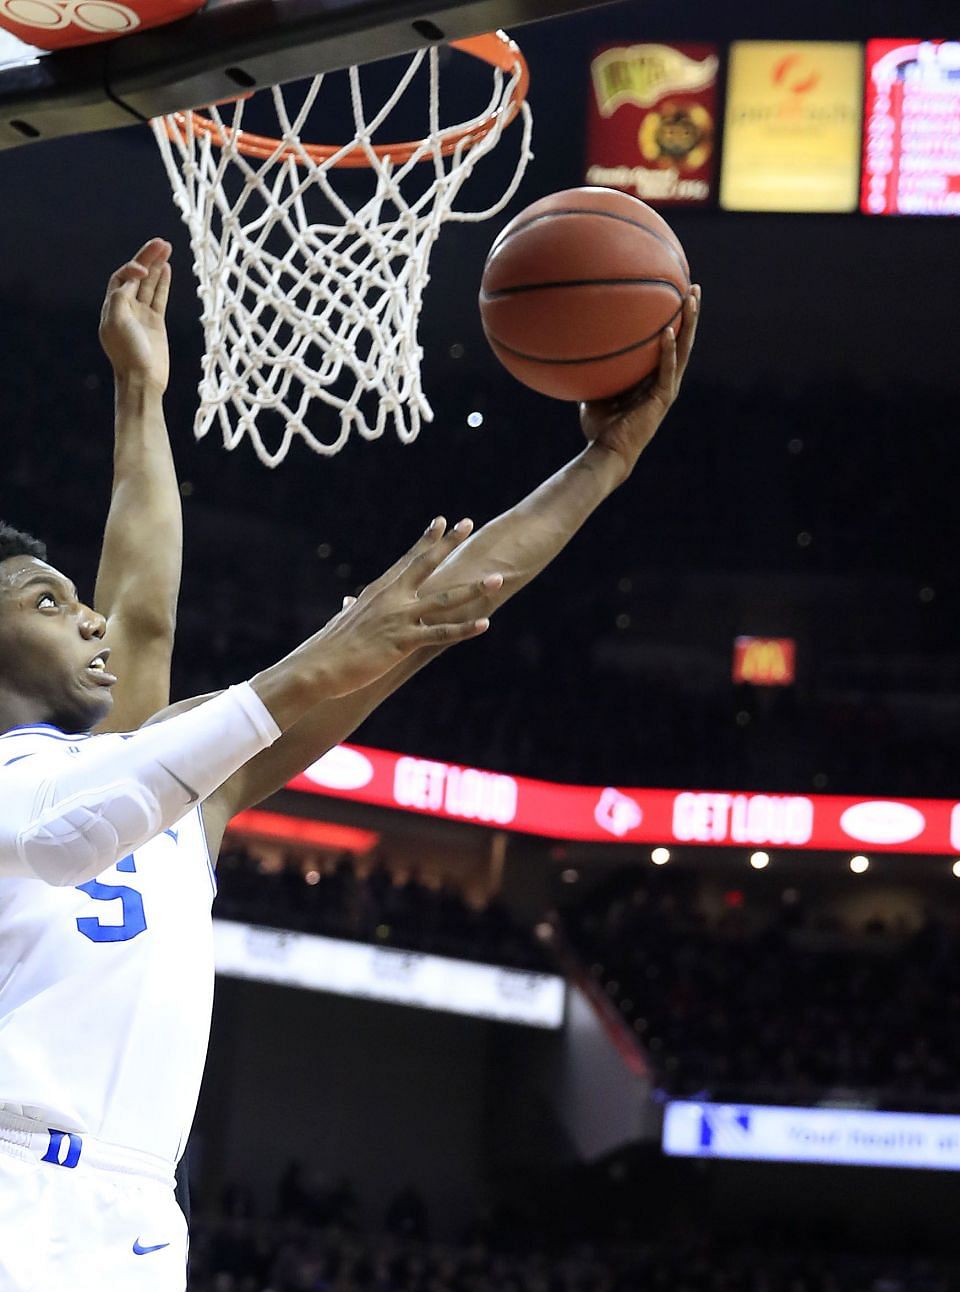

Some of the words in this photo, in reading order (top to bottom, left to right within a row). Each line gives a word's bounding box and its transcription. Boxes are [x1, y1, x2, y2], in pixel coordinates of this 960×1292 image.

[394, 756, 447, 810] GET
[444, 766, 517, 824] LOUD
[672, 792, 732, 842] GET
[730, 795, 814, 845] LOUD
